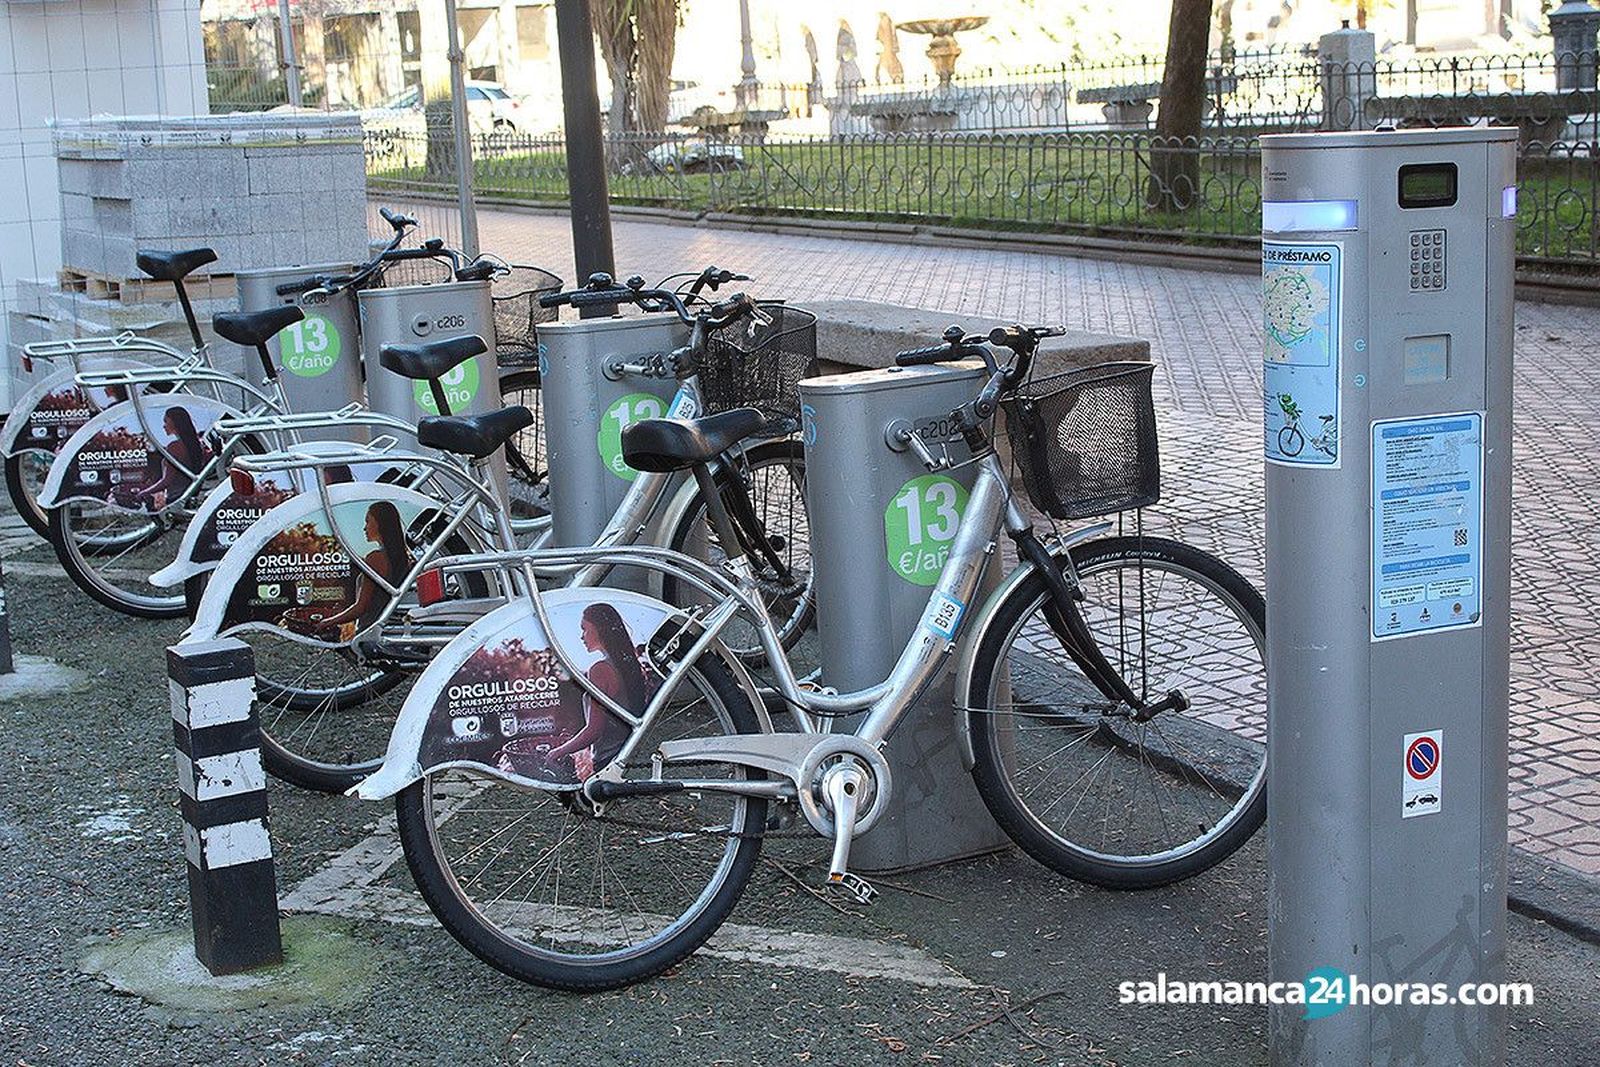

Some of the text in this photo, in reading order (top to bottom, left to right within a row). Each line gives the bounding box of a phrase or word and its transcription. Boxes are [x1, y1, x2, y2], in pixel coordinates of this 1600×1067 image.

[1277, 249, 1332, 262] PRÉSTAMO
[437, 315, 465, 329] c206
[286, 317, 329, 353] 13
[288, 353, 333, 370] €/año
[78, 448, 148, 461] ORGULLOSOS
[896, 482, 960, 546] 13
[256, 552, 350, 568] ORGULLOSOS
[899, 545, 949, 574] €/añ
[1077, 551, 1122, 569] MICHELIN
[256, 574, 304, 582] ORGULLOSOS
[316, 571, 351, 579] RECICLAR
[267, 566, 303, 575] NUESTROS
[304, 564, 351, 572] ATARDECERES
[934, 602, 956, 629] B135
[448, 676, 559, 700] ORGULLOSOS
[448, 691, 560, 709] DE NUESTROS ATARDECERES
[448, 699, 561, 717] ORGULLOSOS DE RECICLAR
